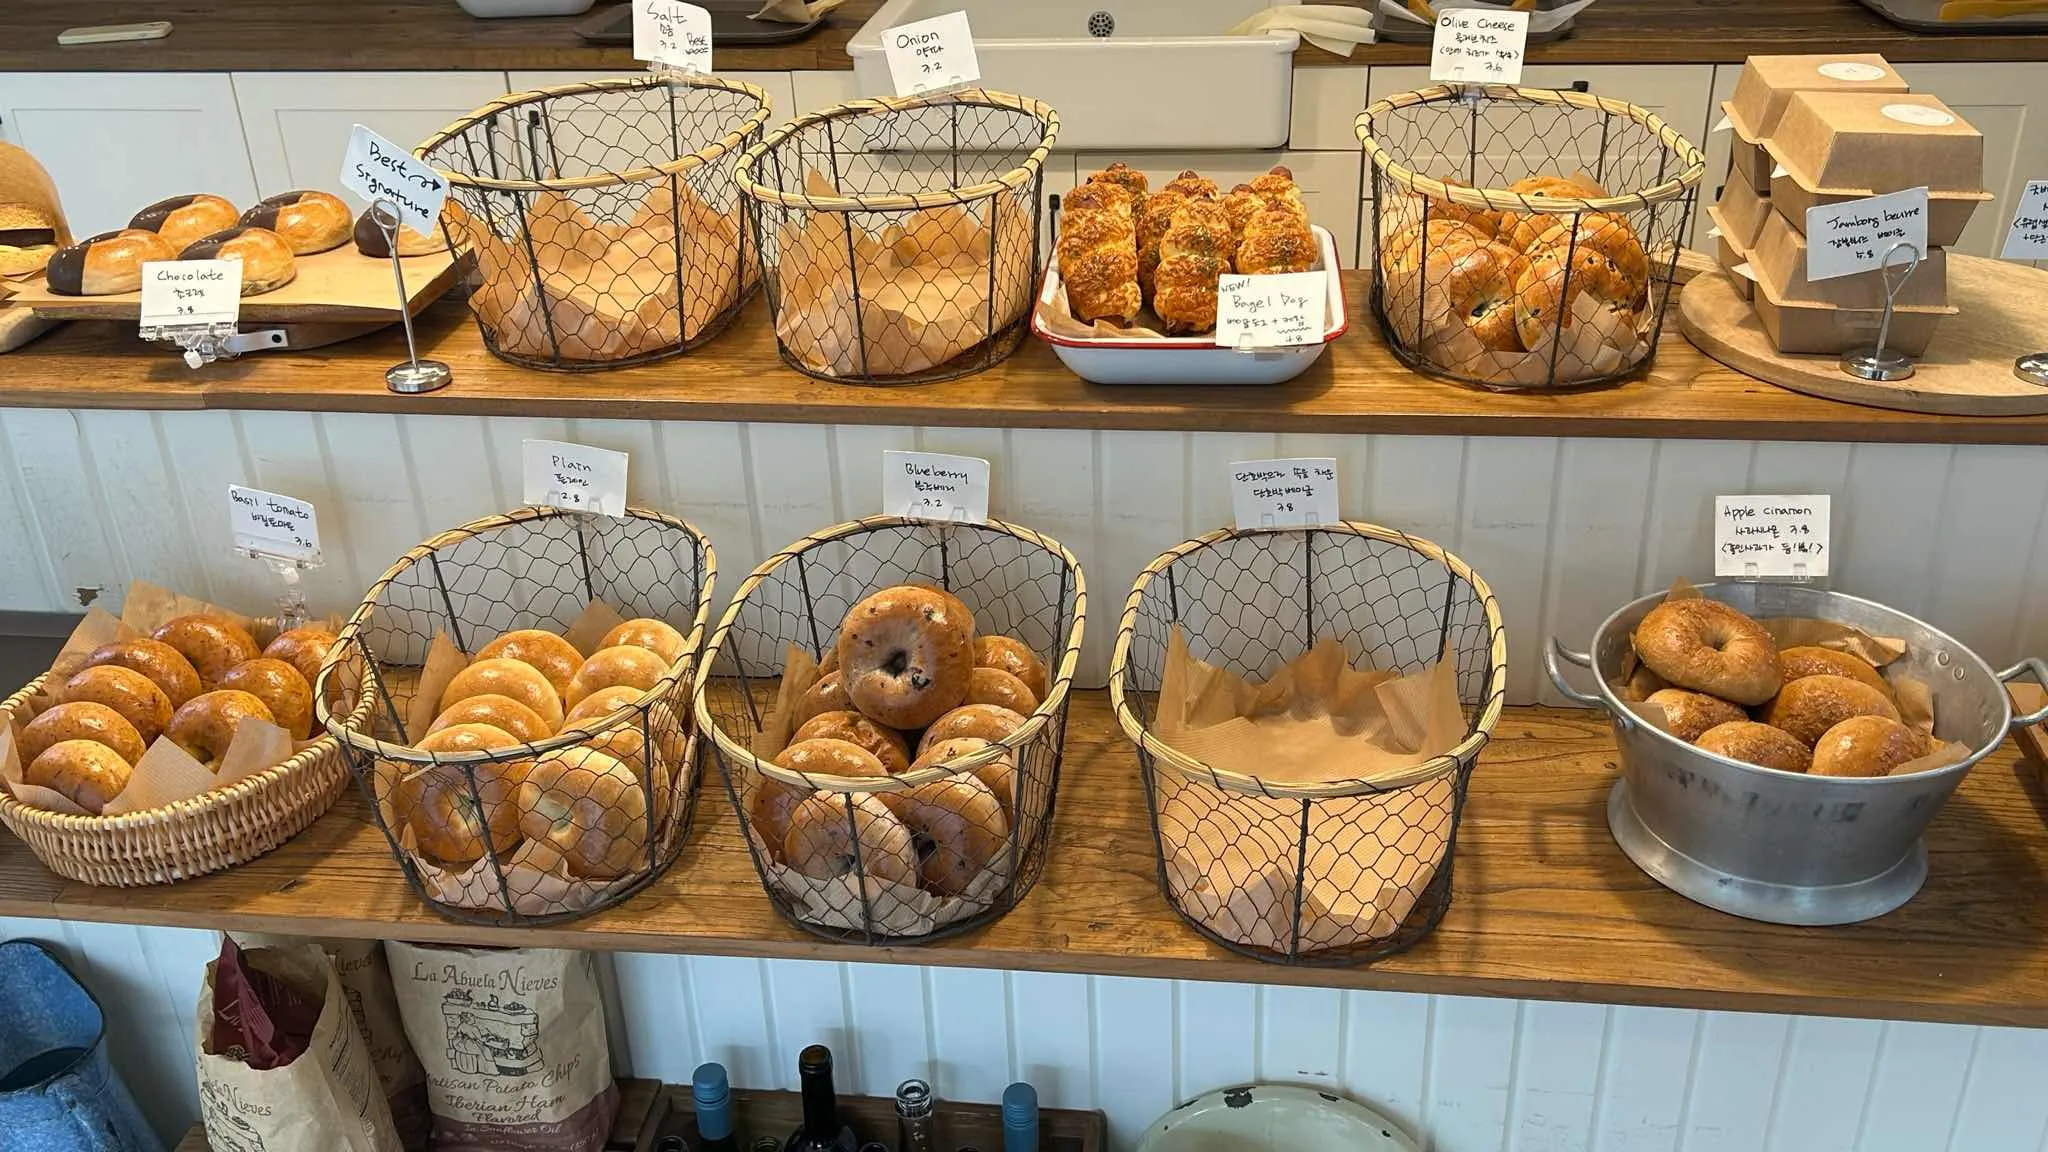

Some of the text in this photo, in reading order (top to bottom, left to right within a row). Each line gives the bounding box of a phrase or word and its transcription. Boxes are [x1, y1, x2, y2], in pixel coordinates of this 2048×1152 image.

[647, 1, 687, 24] Salt
[1441, 17, 1515, 31] Olive Cheese
[897, 32, 940, 48] Onion
[916, 46, 944, 57] 양파
[921, 62, 942, 73] 3.2
[370, 141, 406, 178] Best
[356, 164, 429, 218] Signature
[157, 267, 224, 281] Chocolate
[1221, 278, 1250, 292] NEW!
[1232, 292, 1308, 313] Bagel Dog
[552, 455, 591, 471] Plain
[554, 473, 589, 486] 플레인
[905, 463, 968, 484] Blueberry
[915, 480, 955, 491] 블루베리
[231, 490, 309, 519] Basil tomato
[561, 492, 580, 503] 2.8
[924, 498, 942, 507] 3.2
[1724, 506, 1755, 520] Apple
[1790, 525, 1810, 534] 3.8
[295, 536, 312, 547] 3.6
[412, 962, 558, 996] La Abuela Nieves
[482, 1078, 537, 1094] Potato
[541, 1053, 581, 1088] Chips
[223, 1083, 272, 1117] Nieves
[445, 1094, 567, 1113] Iberian Ham
[472, 1108, 542, 1123] Flavored
